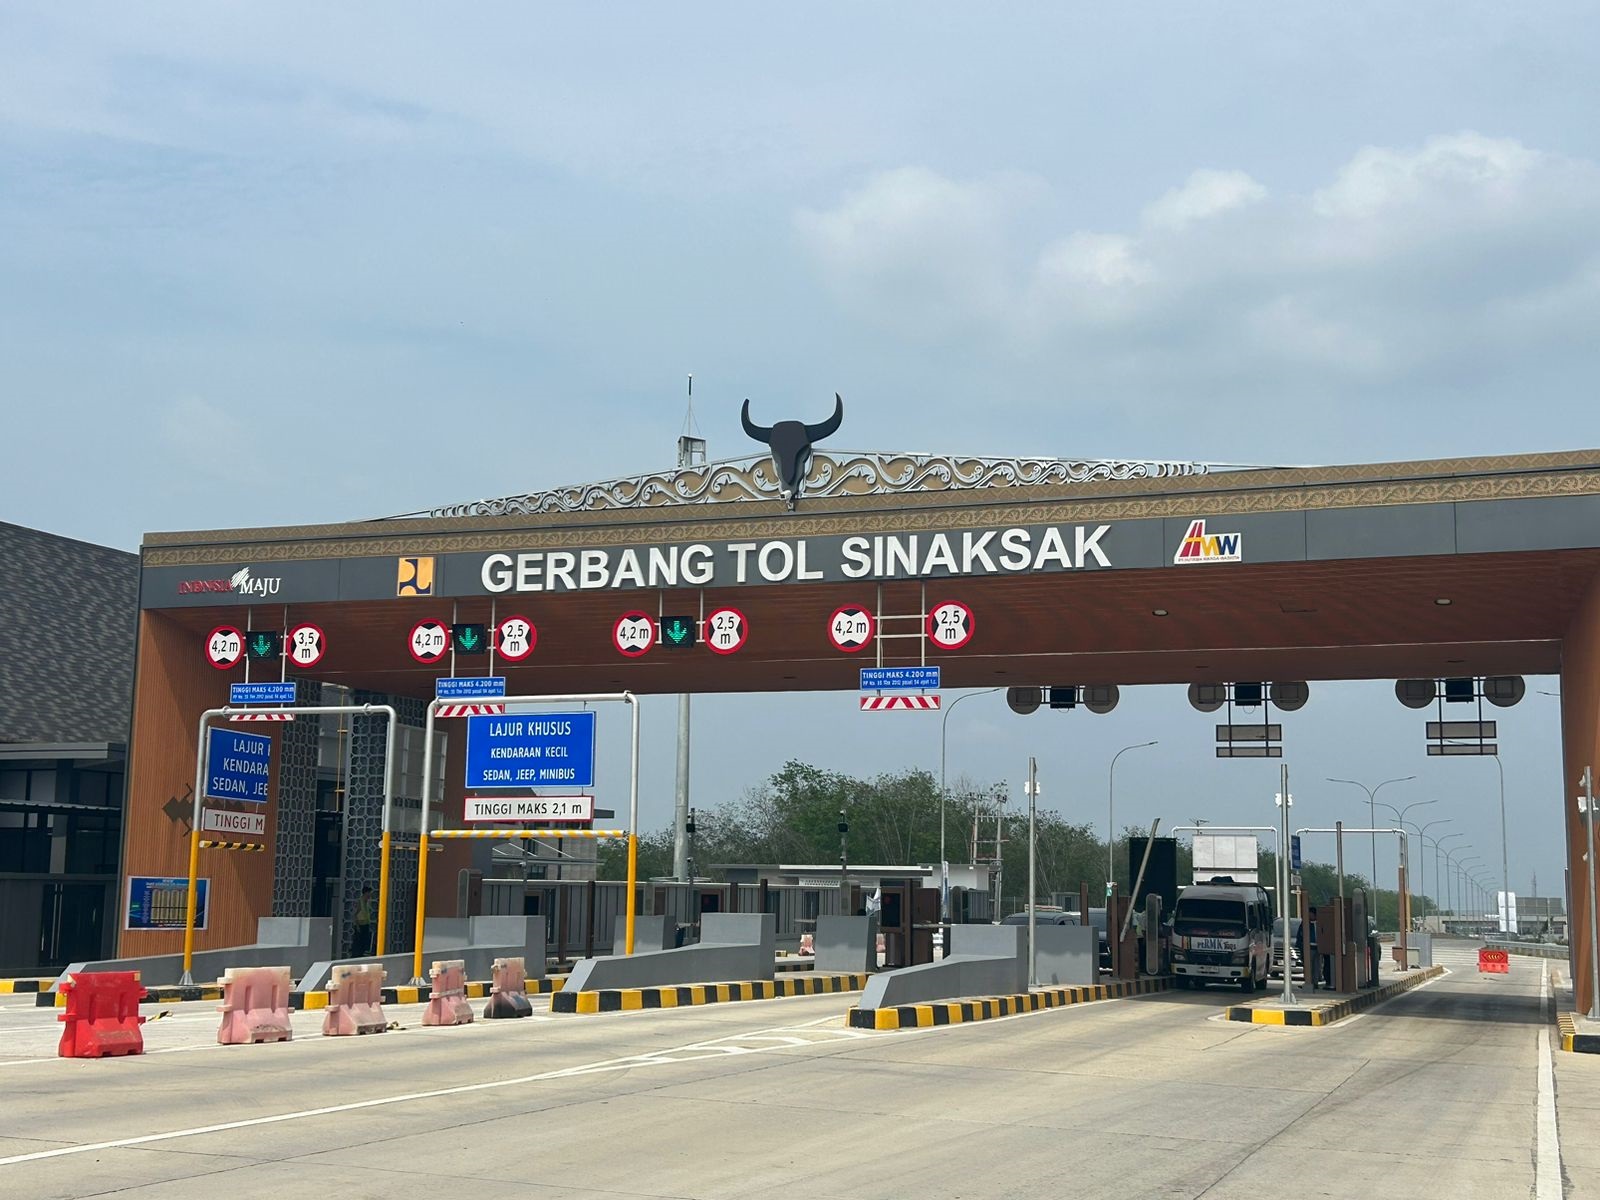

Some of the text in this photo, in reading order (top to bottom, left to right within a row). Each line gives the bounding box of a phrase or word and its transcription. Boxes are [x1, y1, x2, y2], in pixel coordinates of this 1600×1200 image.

[481, 525, 1112, 592] GERBANG TOL SINAKSAK
[239, 577, 281, 597] MAJU
[717, 616, 734, 631] 2,5
[941, 610, 960, 626] 2,5
[507, 625, 524, 639] 2,5
[620, 626, 649, 640] 4,2 m
[835, 620, 867, 636] 4,2 m
[945, 628, 956, 639] m
[298, 632, 314, 646] 3,5
[415, 633, 443, 648] 4,2 m
[720, 633, 731, 644] m
[212, 640, 238, 654] 4,2 m
[301, 648, 311, 658] m
[510, 641, 520, 651] m
[232, 686, 251, 694] TINGGI
[489, 721, 571, 736] LAJUR KHUSUS
[233, 738, 264, 755] LAJUR
[490, 746, 568, 759] KENDARAAN KECIL
[483, 768, 575, 781] SEDAN, JEEP, MINIBUS
[212, 777, 249, 795] SEDAN,
[475, 803, 582, 816] TINGGI MAKS 2,1 m
[214, 813, 251, 830] TINGGI
